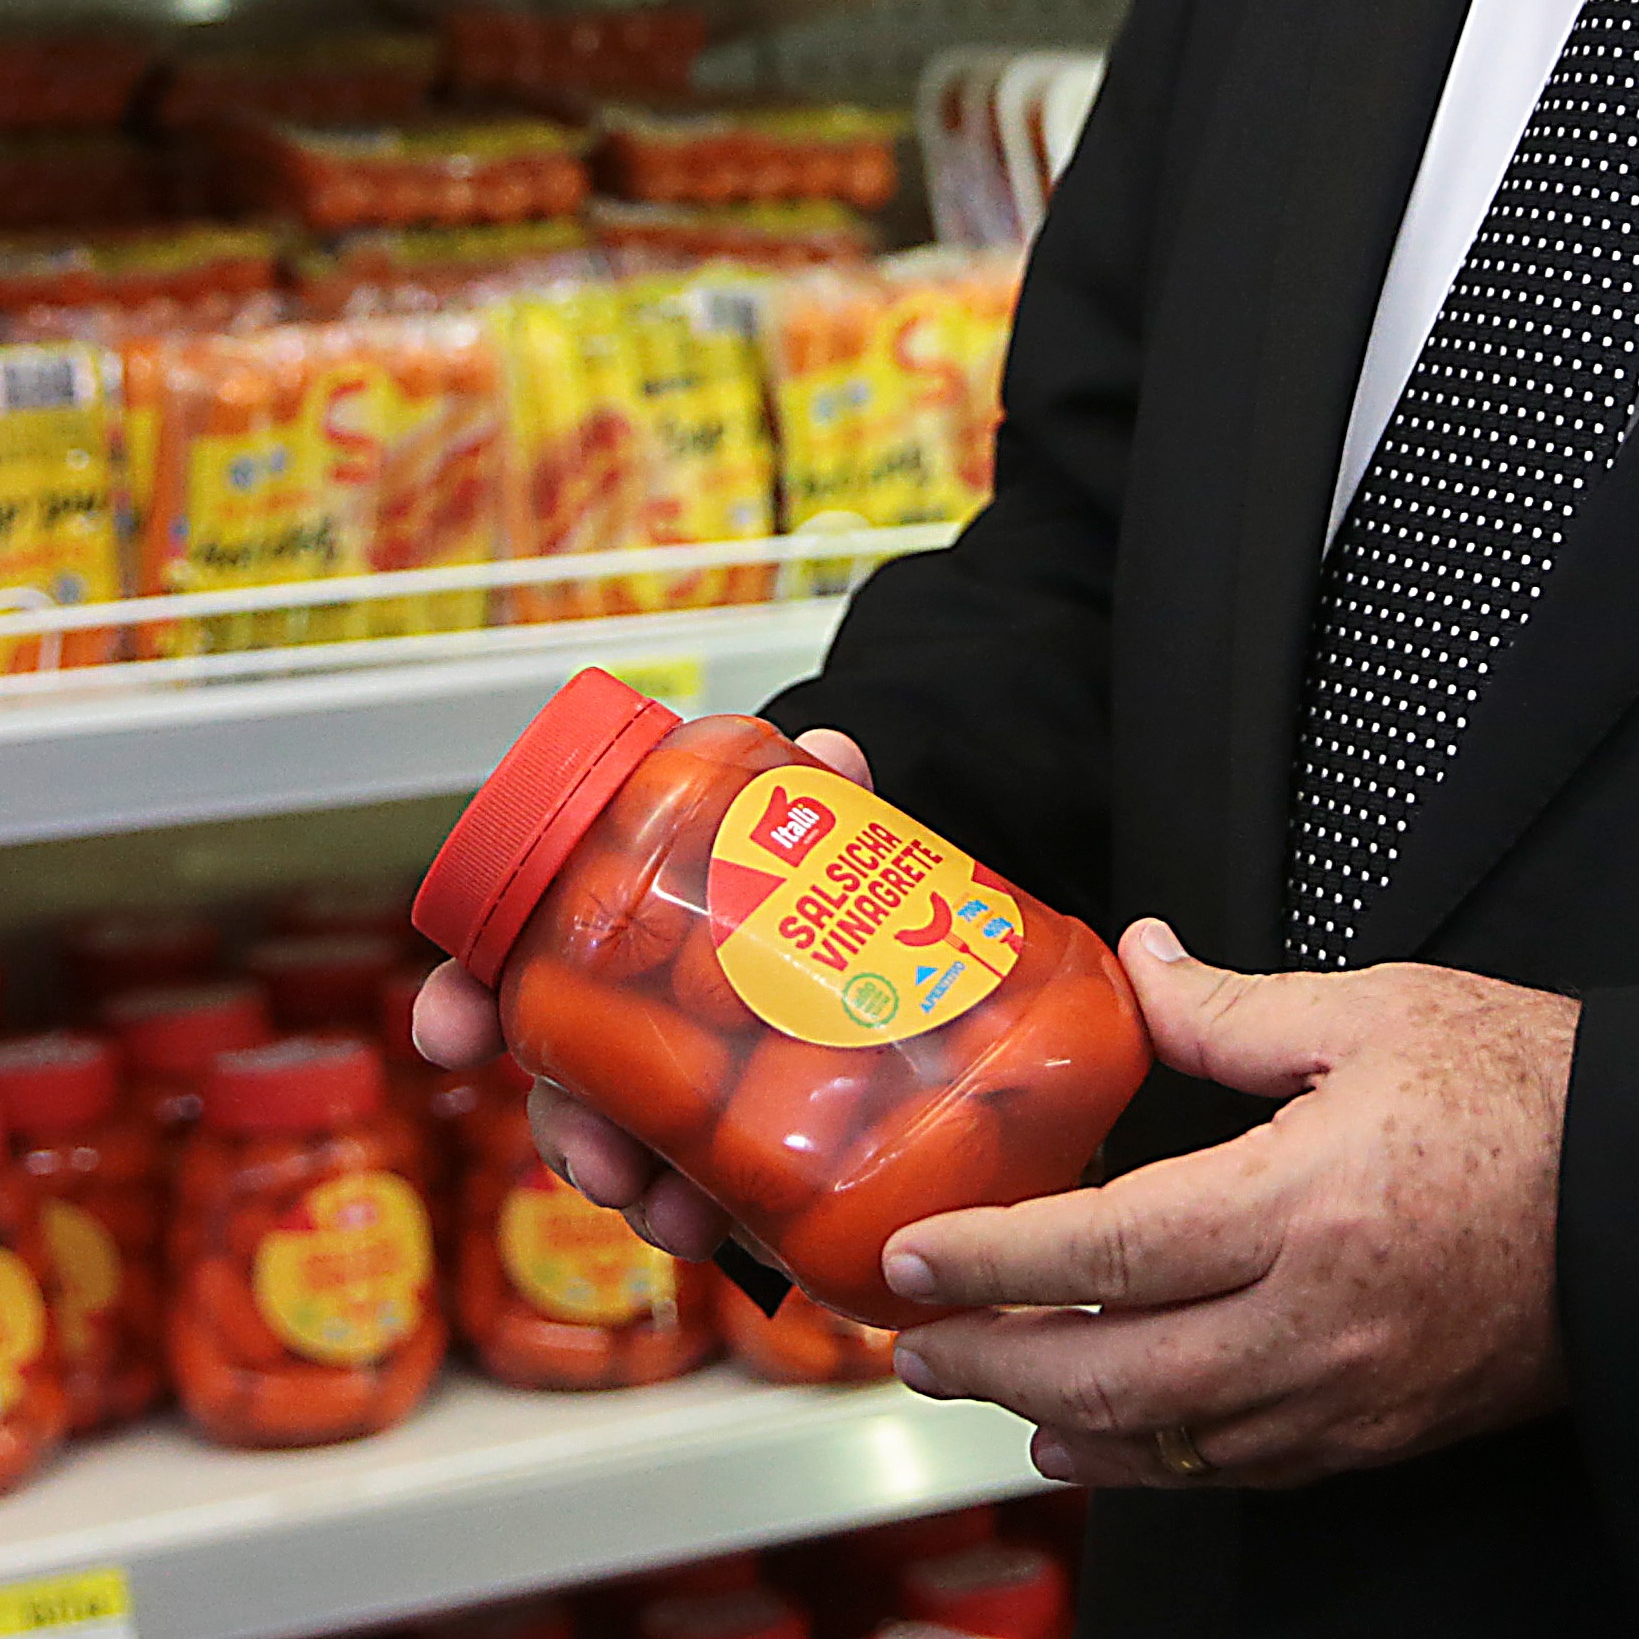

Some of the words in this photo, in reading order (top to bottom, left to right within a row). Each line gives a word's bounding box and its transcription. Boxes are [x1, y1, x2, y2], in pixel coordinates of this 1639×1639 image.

[770, 802, 820, 849] Italli
[779, 822, 902, 949] SALSICHA
[812, 839, 944, 971] VINAGRETE
